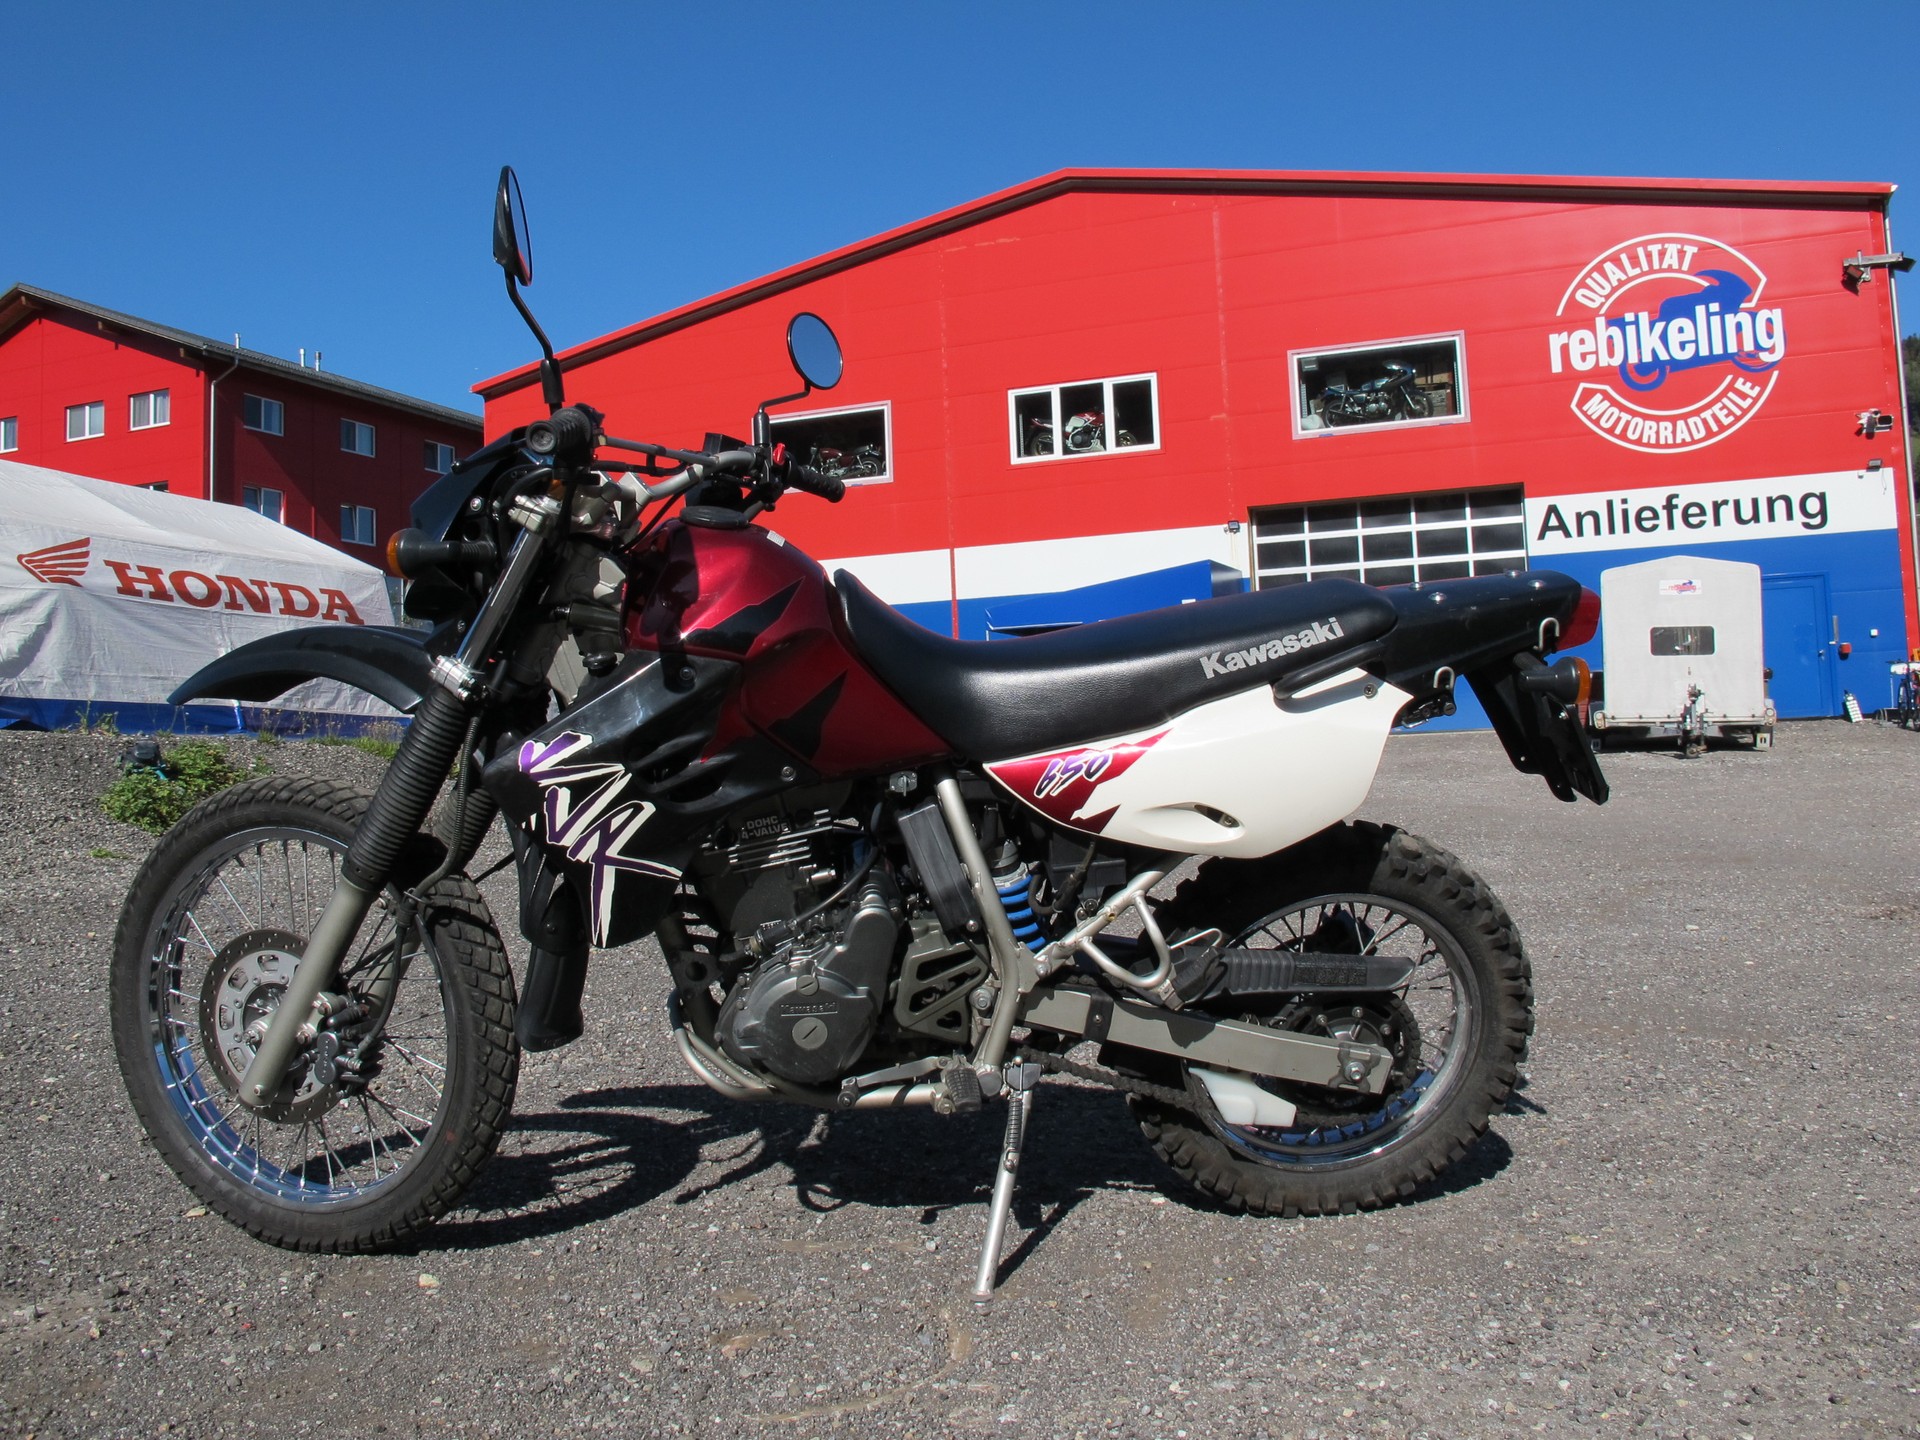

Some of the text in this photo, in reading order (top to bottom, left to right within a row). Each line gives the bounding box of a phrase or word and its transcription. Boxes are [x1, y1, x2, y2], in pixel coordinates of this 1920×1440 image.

[1575, 243, 1698, 309] QUALITÄT
[1549, 302, 1784, 373] rebikeling
[1582, 377, 1760, 445] MOTORRADTEILE
[1537, 490, 1828, 541] Anlieferung
[103, 560, 364, 625] HONDA
[1200, 617, 1345, 679] Kawasaki
[1034, 752, 1113, 798] 650
[741, 822, 790, 839] 4-VALVE
[746, 816, 778, 830] DOHC
